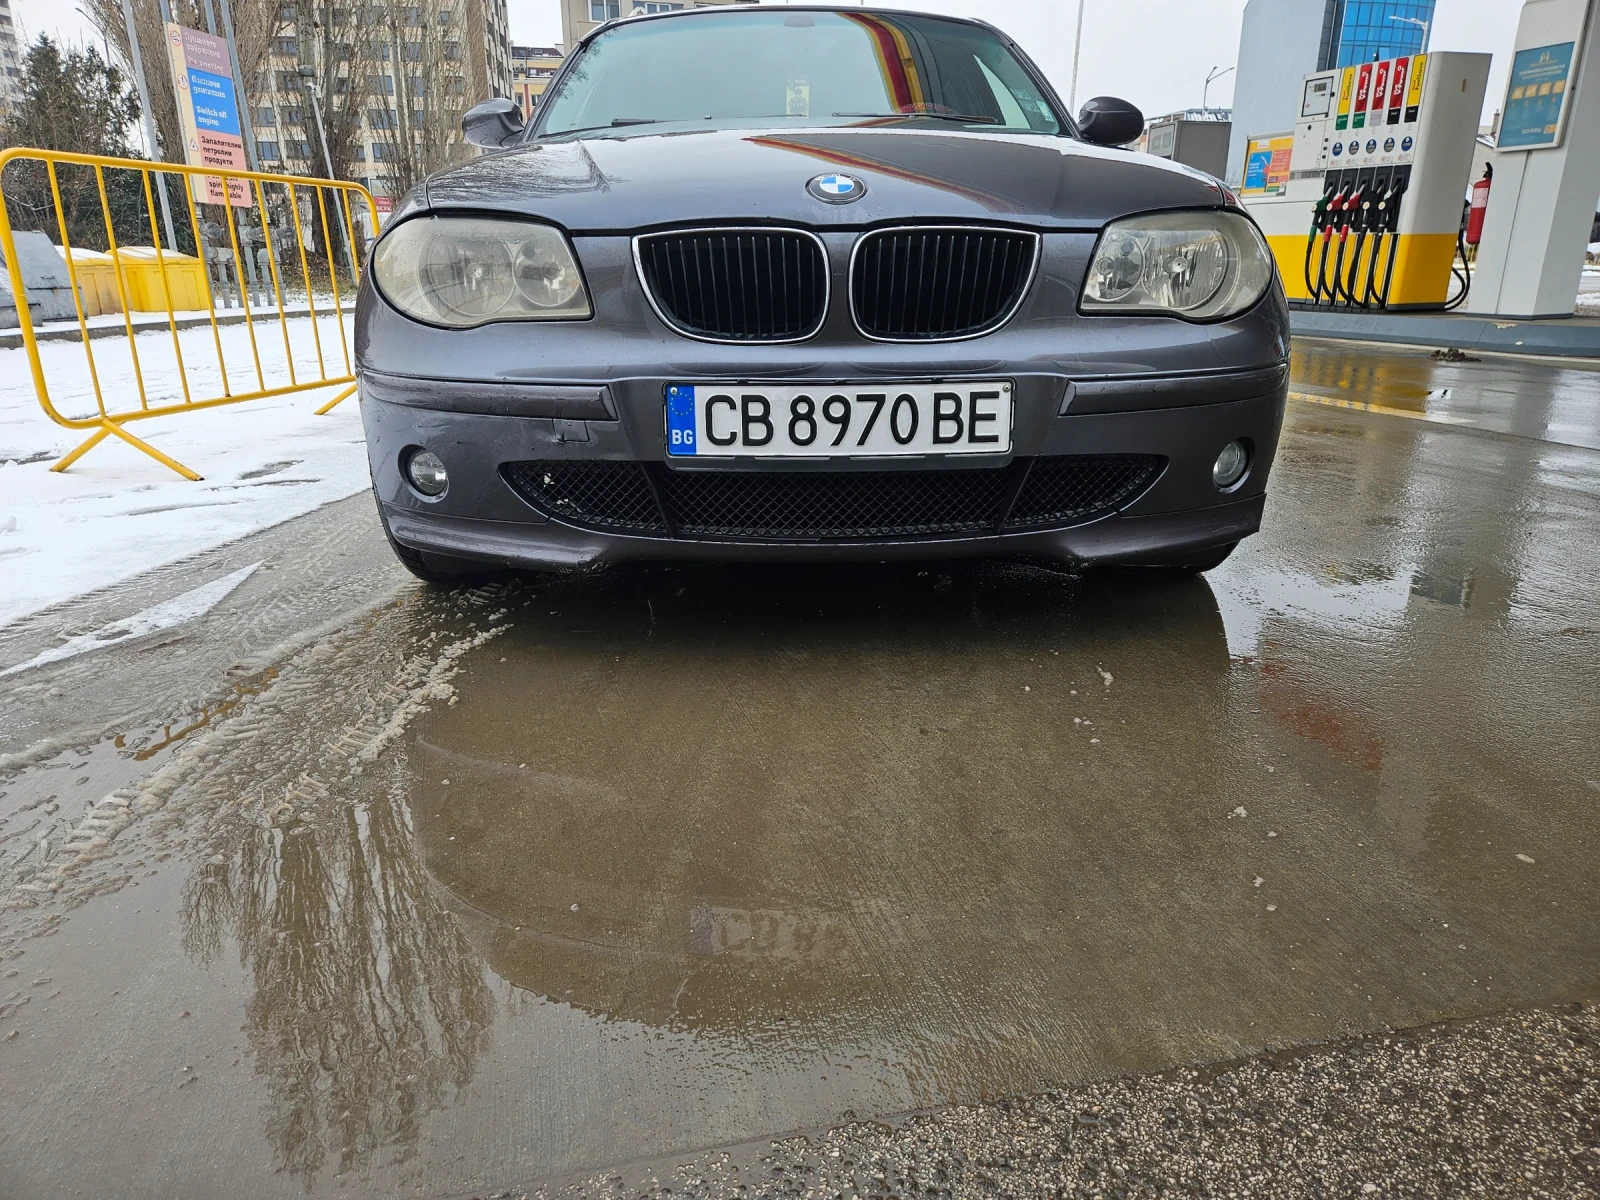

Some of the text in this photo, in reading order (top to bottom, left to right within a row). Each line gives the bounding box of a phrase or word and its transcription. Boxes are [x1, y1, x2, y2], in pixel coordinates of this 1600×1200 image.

[196, 105, 227, 119] Switch off
[198, 116, 220, 126] engine
[201, 135, 242, 149] Запалителни
[202, 146, 233, 157] петролни
[204, 156, 234, 166] продукти
[209, 181, 226, 189] spiri
[210, 189, 242, 200] flamable
[704, 390, 1001, 447] CB 8970 BE
[672, 429, 694, 446] BG
